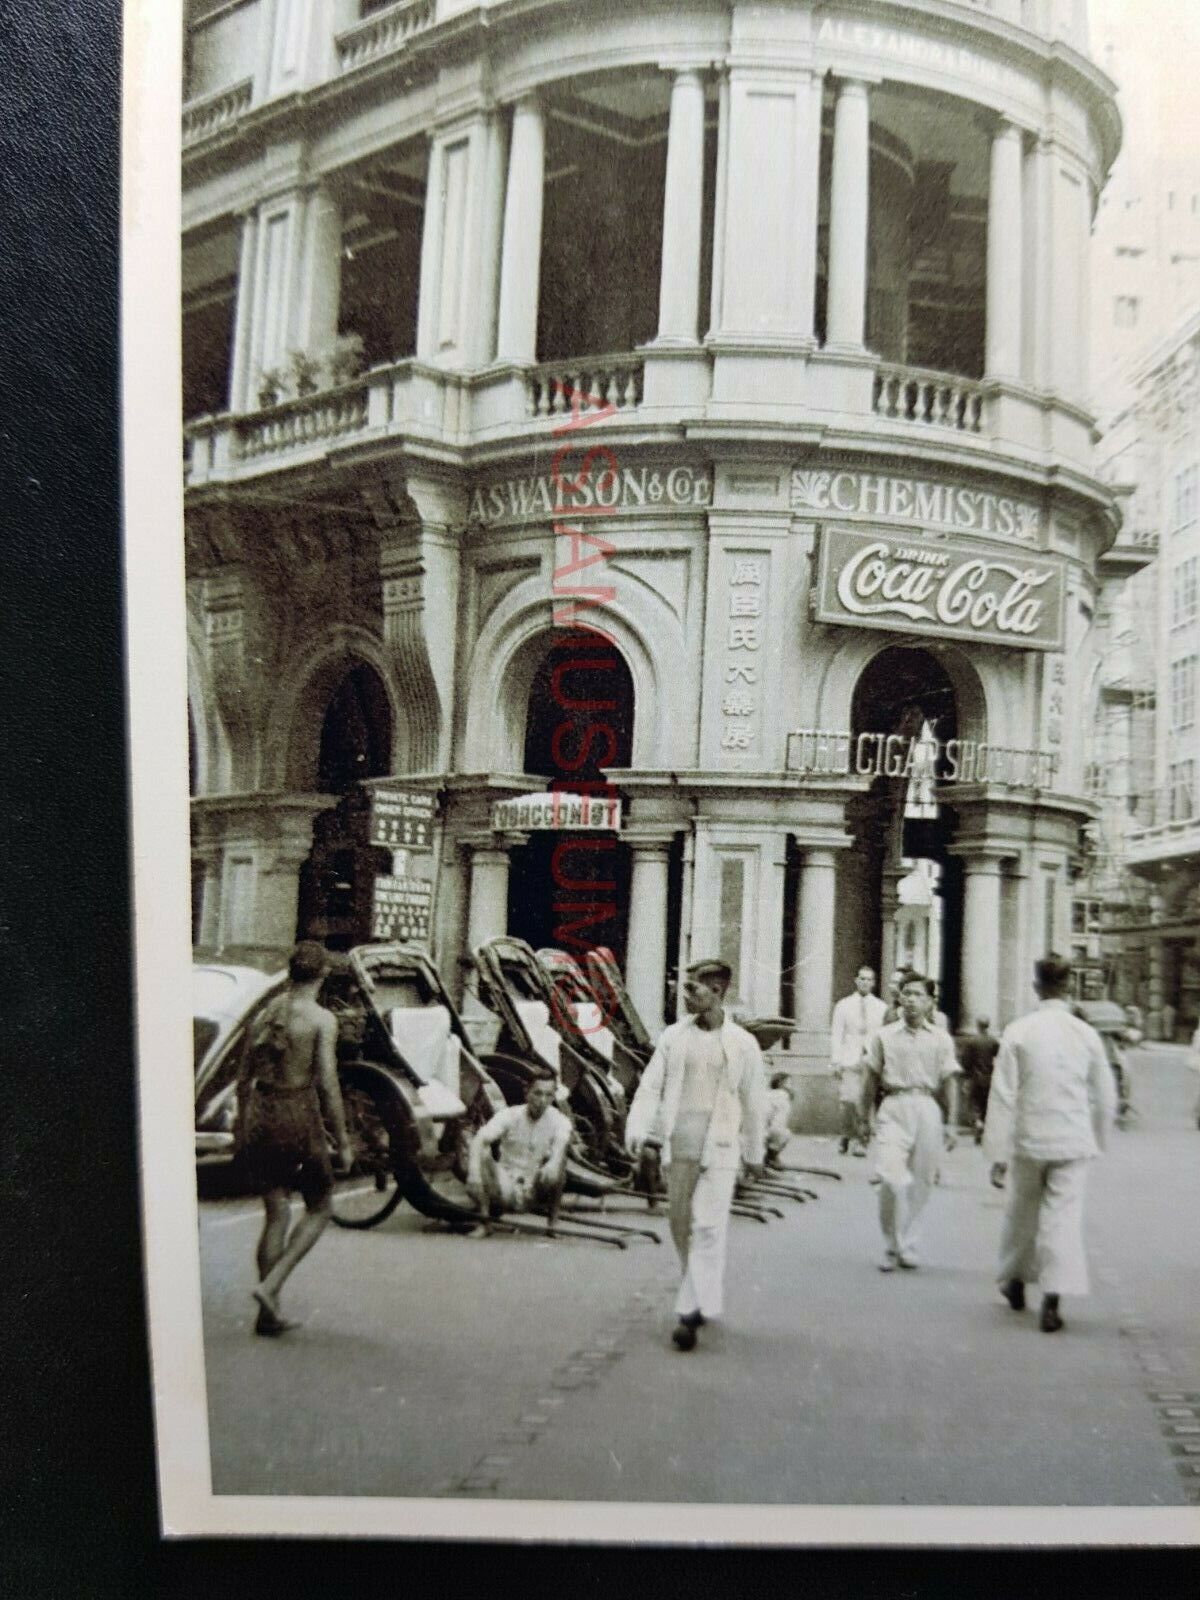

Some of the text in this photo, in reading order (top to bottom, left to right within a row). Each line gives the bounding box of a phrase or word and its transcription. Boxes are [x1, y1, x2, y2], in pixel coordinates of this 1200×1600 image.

[830, 473, 1017, 536] CHEMISTS
[837, 542, 1054, 634] Coca-Cola
[894, 548, 950, 566] DRINK
